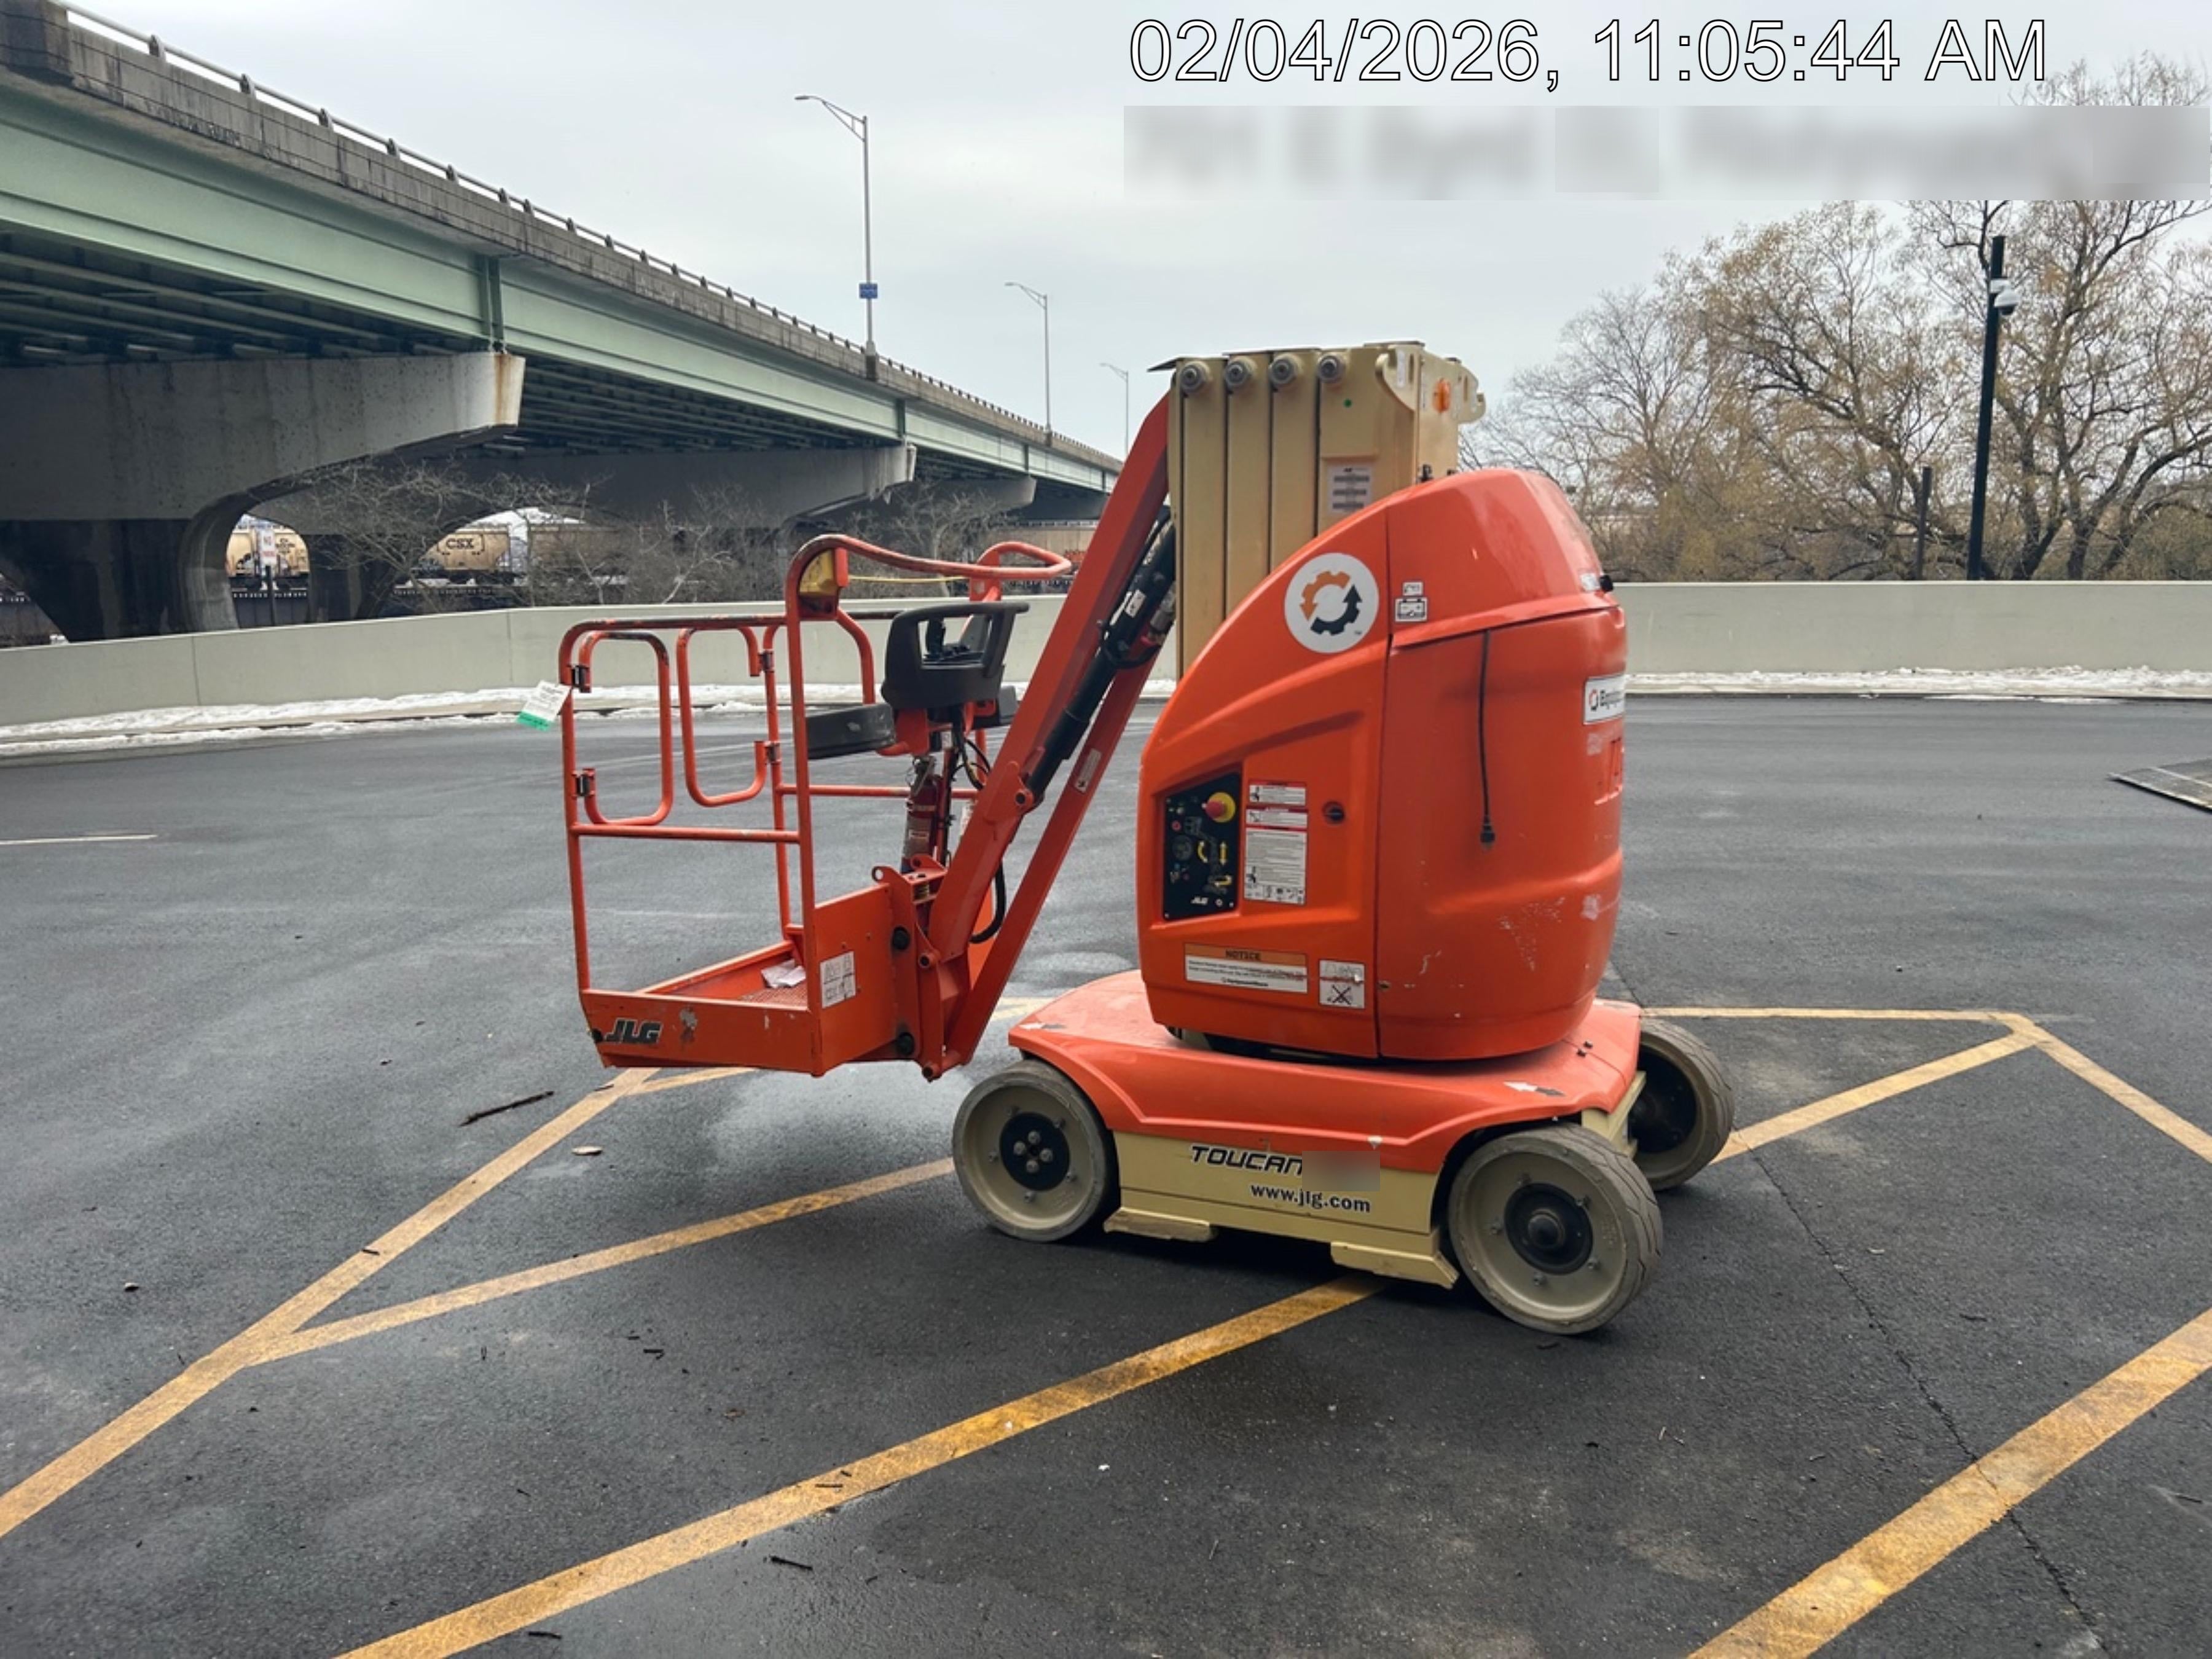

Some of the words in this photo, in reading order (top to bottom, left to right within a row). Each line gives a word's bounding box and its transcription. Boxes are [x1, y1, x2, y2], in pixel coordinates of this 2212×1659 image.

[446, 538, 474, 550] CSX
[1225, 949, 1261, 962] NOTICE
[605, 1018, 662, 1044] JLG
[1191, 1145, 1303, 1175] TOUCAN
[1250, 1183, 1371, 1213] www.jlg.com
